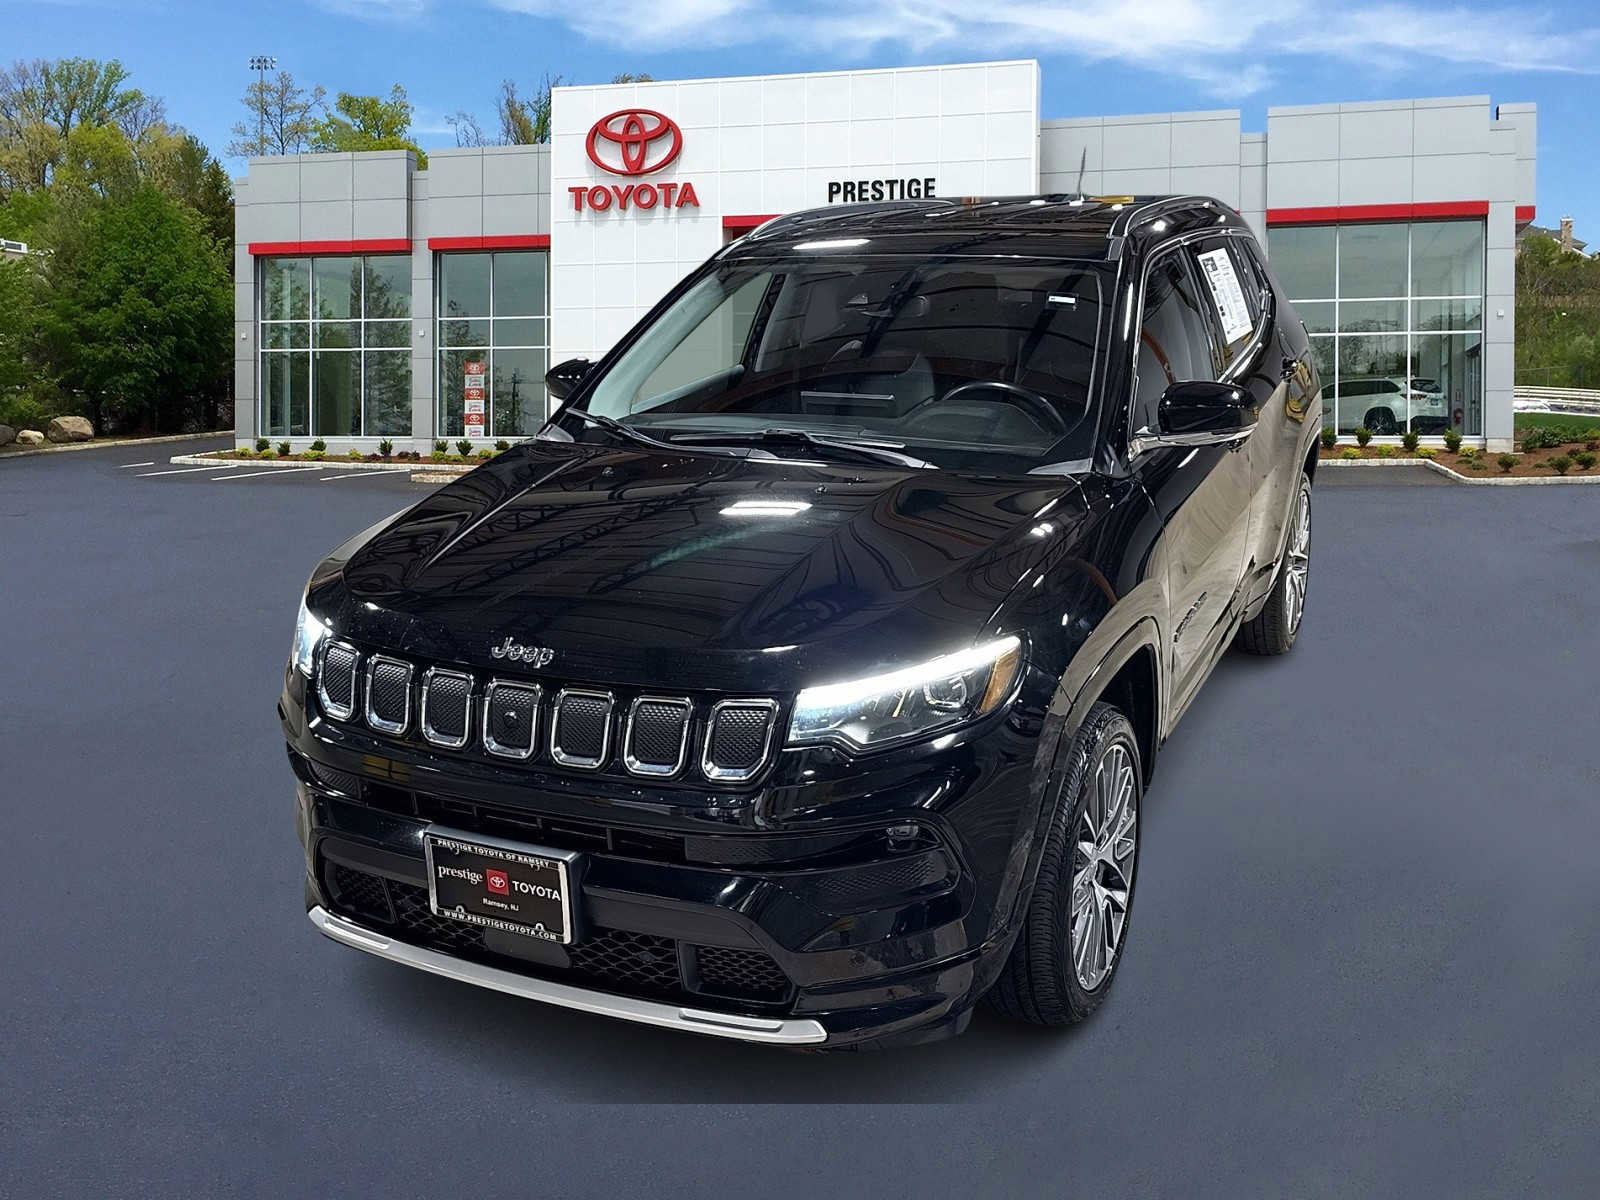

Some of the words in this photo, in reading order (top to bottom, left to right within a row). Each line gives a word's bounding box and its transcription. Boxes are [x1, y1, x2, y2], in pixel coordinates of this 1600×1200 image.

[568, 182, 700, 211] TOYOTA
[828, 178, 936, 203] PRESTIGE
[491, 636, 555, 668] Jeep
[437, 839, 473, 852] PRESTIGE
[474, 846, 504, 859] TOYOTA
[505, 853, 517, 861] OF
[518, 855, 550, 868] RAMSEY
[438, 865, 484, 885] prestige
[512, 880, 561, 901] TOYOTA
[443, 909, 557, 941] WWW.PRESTIGETOYOTA.COM
